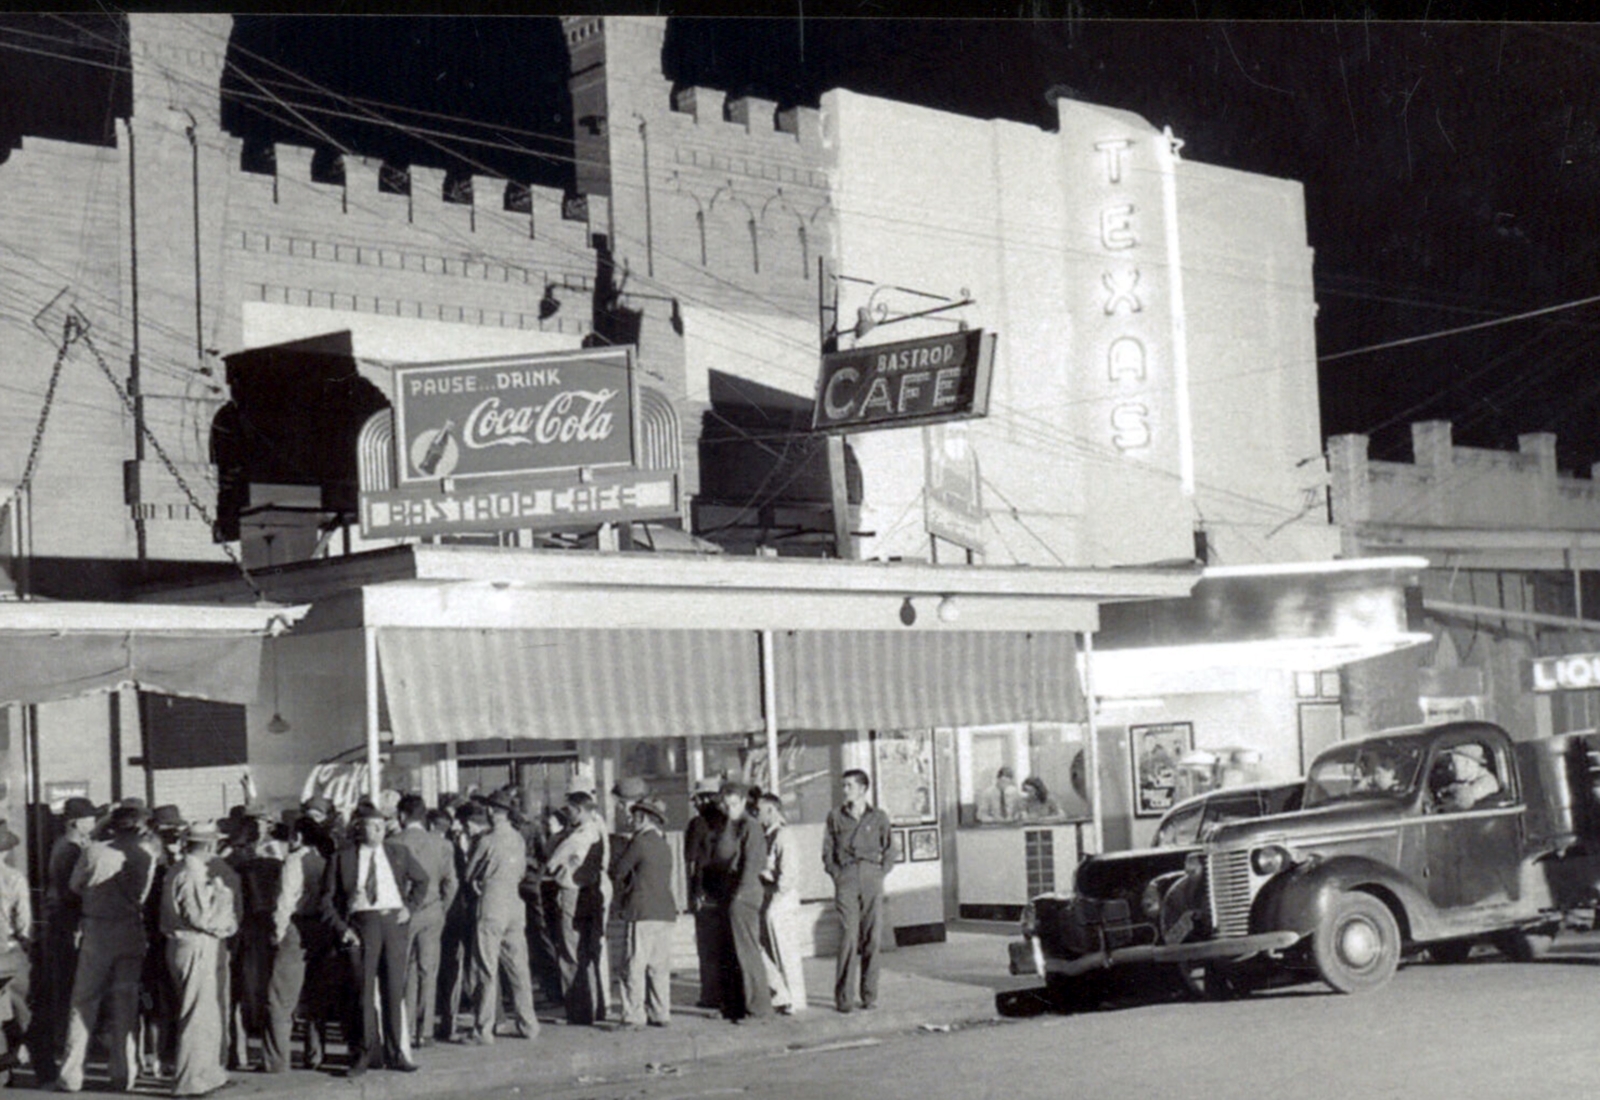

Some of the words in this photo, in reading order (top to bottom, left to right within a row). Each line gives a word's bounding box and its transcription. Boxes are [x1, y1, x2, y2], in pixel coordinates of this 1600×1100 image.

[1095, 139, 1150, 451] TEXAS
[877, 344, 953, 372] BASTROP
[463, 388, 619, 449] Coca-Cola
[824, 366, 961, 420] CAFE
